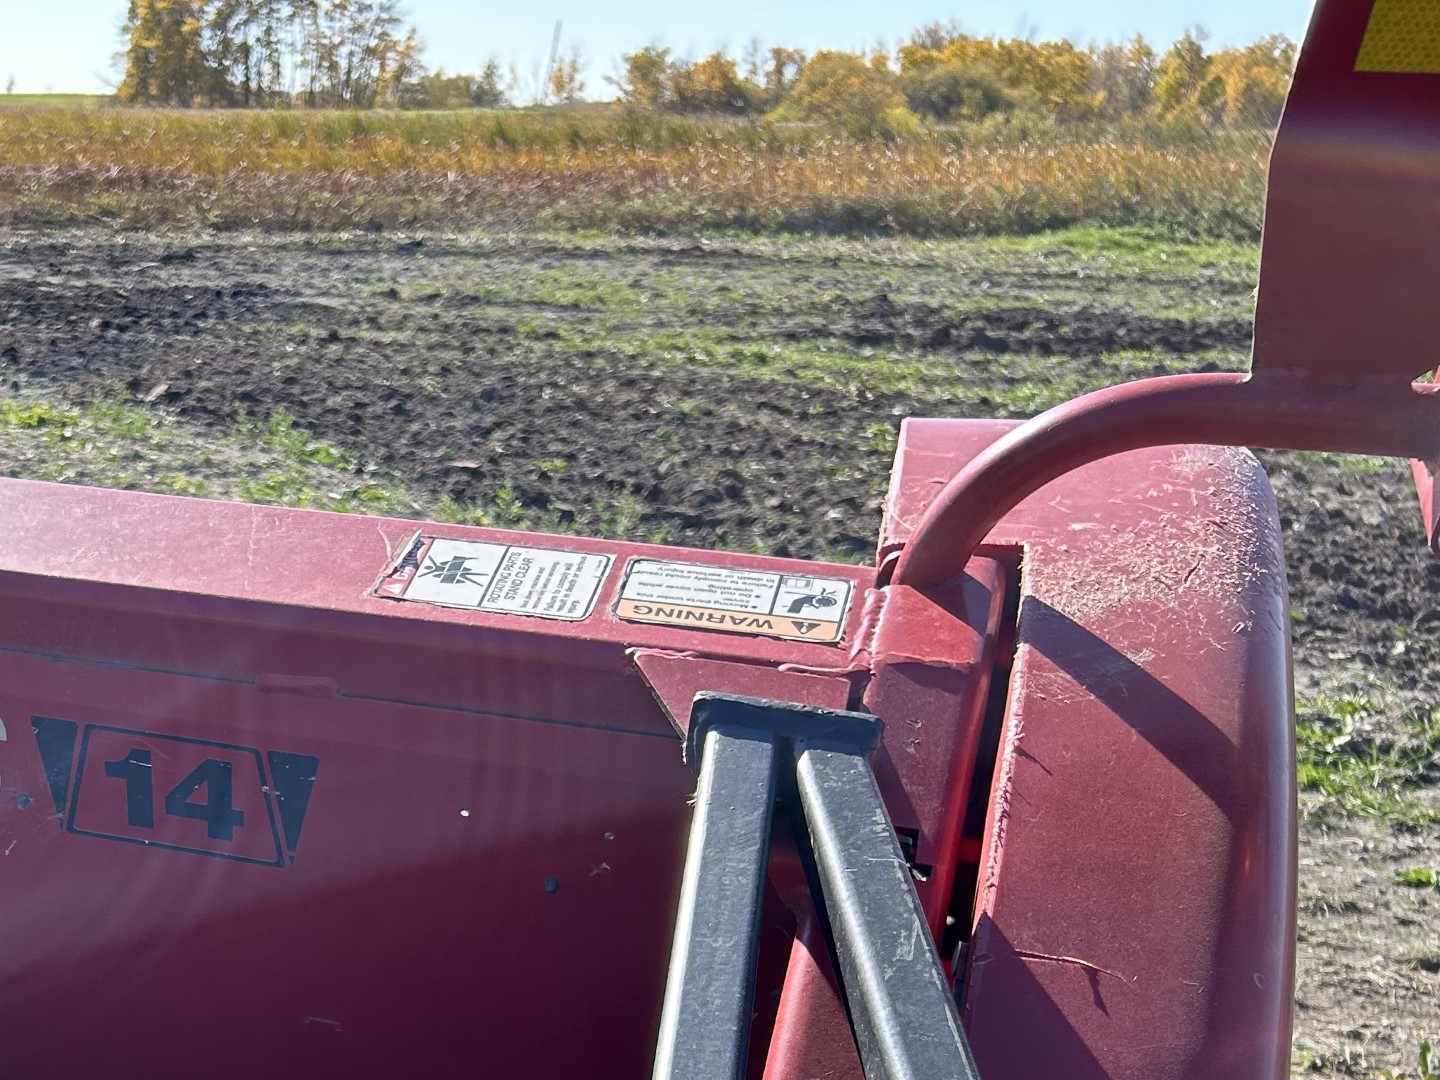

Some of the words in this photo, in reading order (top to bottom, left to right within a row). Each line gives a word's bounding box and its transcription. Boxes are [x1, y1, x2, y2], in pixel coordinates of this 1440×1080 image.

[489, 573, 510, 603] ROTATING
[504, 552, 520, 571] PARTS
[505, 579, 522, 600] STAND
[516, 558, 533, 578] CLEAR
[630, 604, 775, 629] WARNING
[713, 600, 748, 608] Moving
[103, 748, 244, 842] 14
